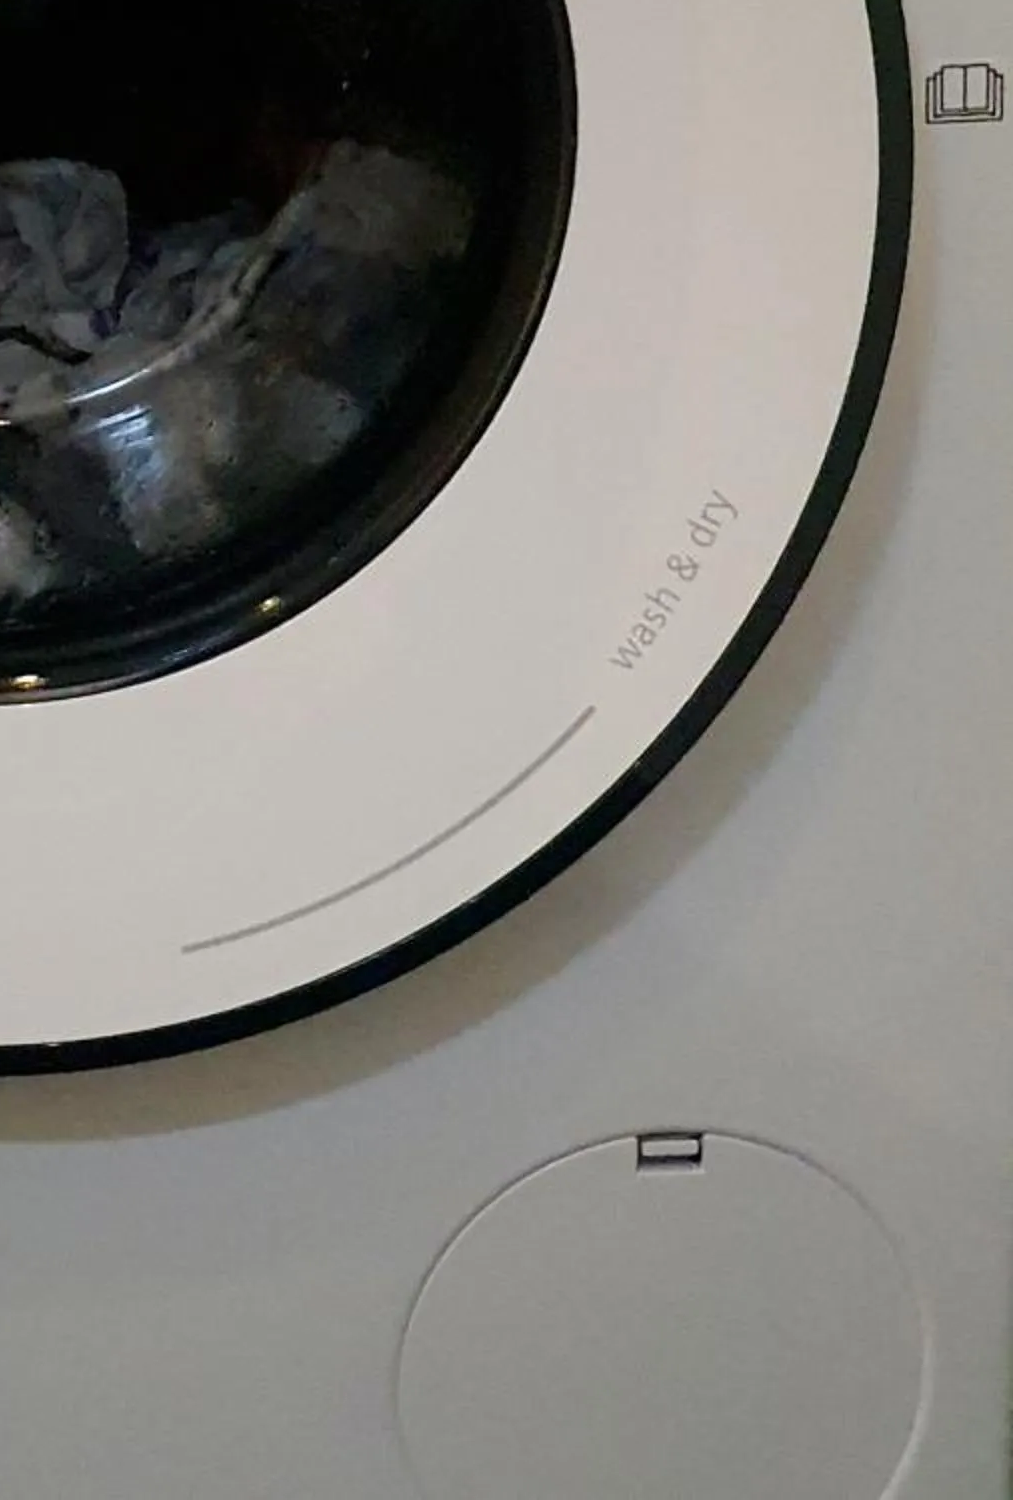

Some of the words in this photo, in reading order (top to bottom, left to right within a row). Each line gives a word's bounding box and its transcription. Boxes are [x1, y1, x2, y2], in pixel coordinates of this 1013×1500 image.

[607, 586, 681, 670] wash
[666, 553, 700, 582] &
[686, 489, 739, 548] dry
